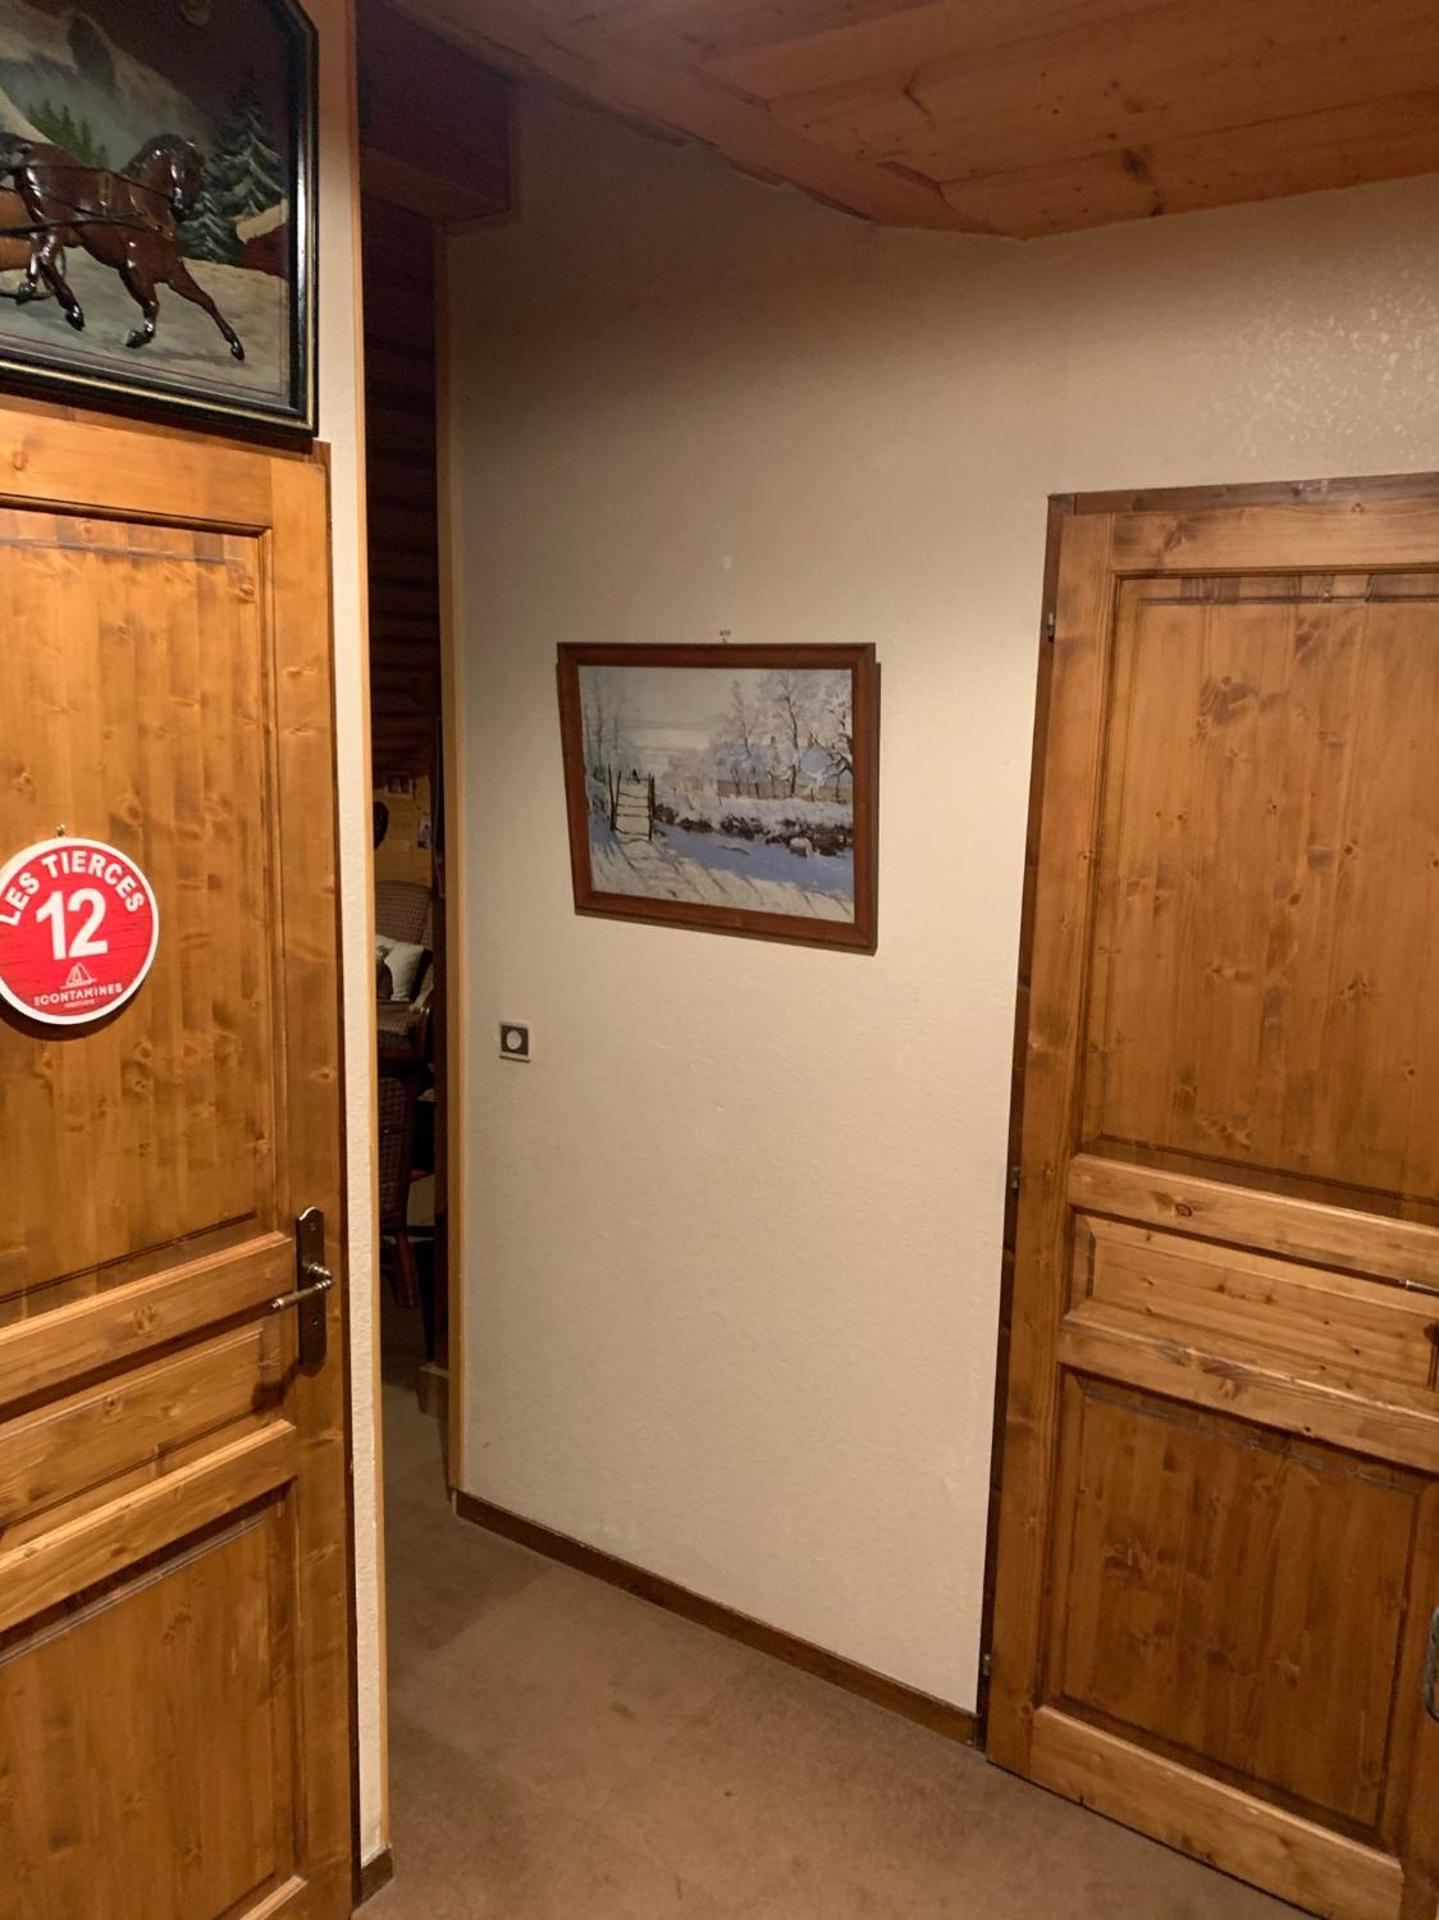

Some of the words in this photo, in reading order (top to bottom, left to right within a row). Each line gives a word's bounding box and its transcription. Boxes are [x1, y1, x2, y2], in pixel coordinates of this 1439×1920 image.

[0, 872, 40, 926] LES
[41, 850, 144, 912] TIERCES
[36, 887, 109, 960] 12
[40, 983, 122, 1005] CONTAMINES
